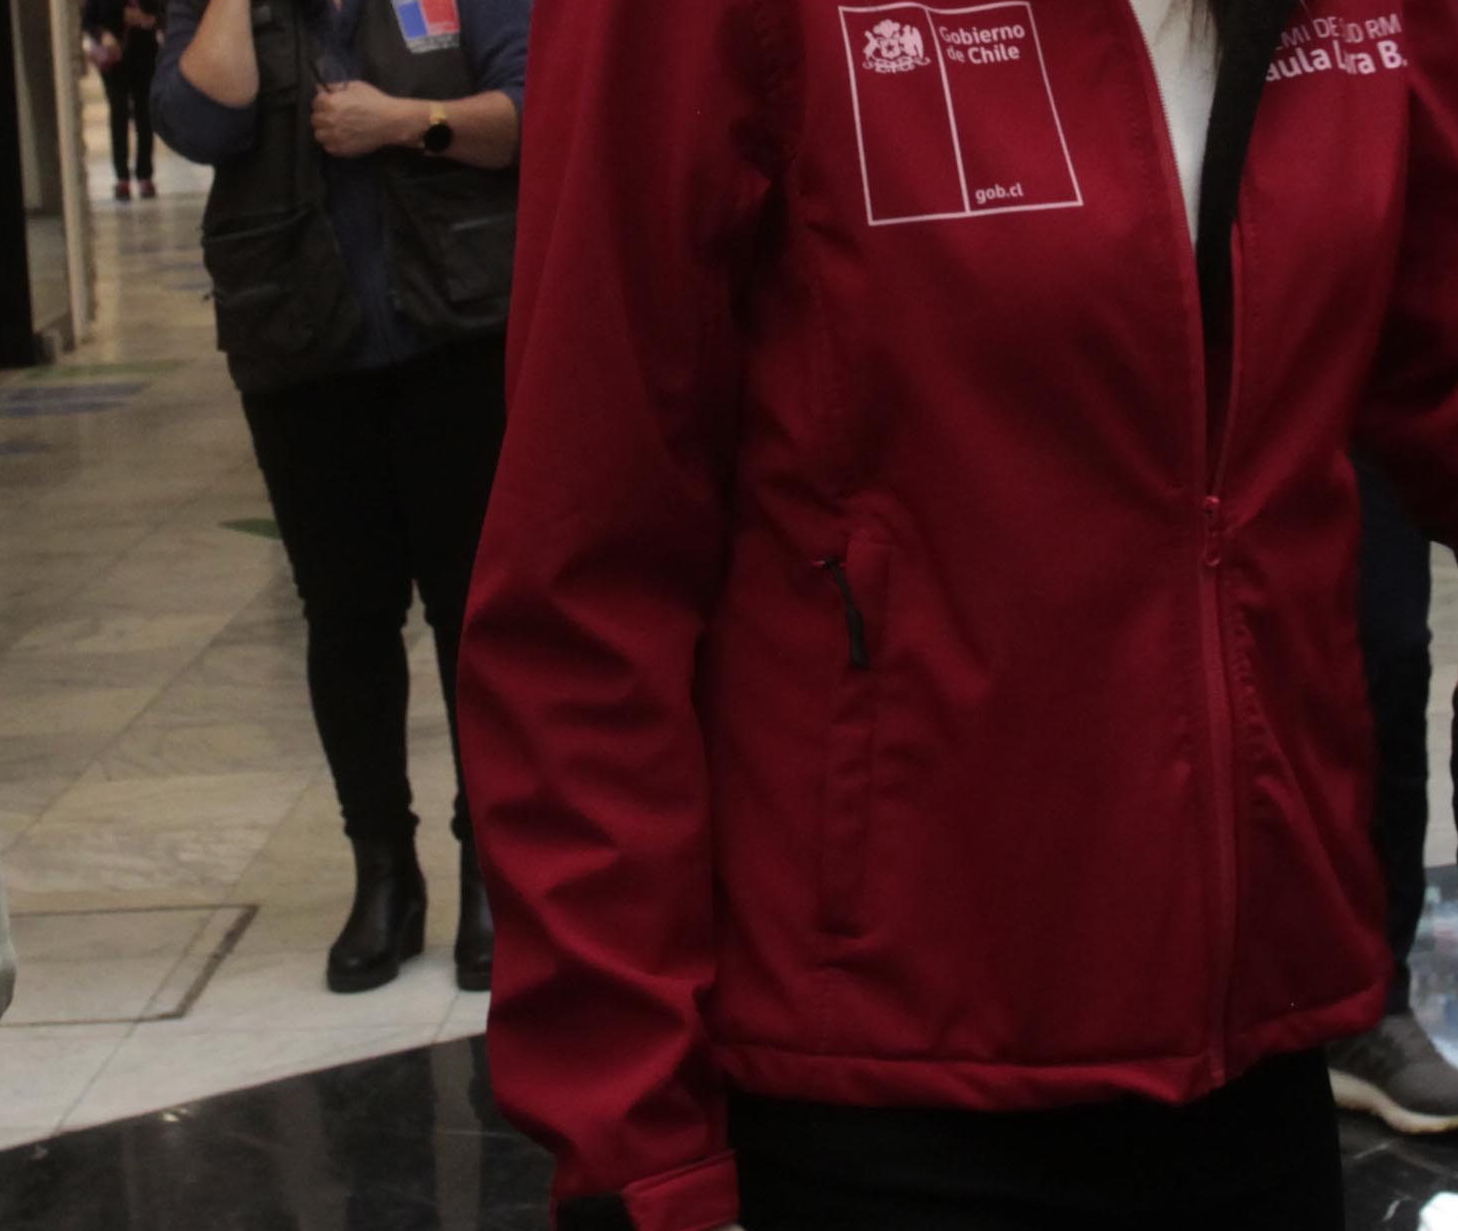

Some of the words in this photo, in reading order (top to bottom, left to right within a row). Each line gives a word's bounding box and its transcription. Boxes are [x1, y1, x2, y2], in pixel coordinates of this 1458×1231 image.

[939, 23, 1026, 46] Gobierno
[1364, 13, 1402, 41] RM
[946, 46, 966, 63] de
[967, 43, 1021, 65] Chile
[1265, 45, 1333, 82] aula
[1376, 39, 1408, 70] B.
[974, 181, 1025, 205] gob.cl
